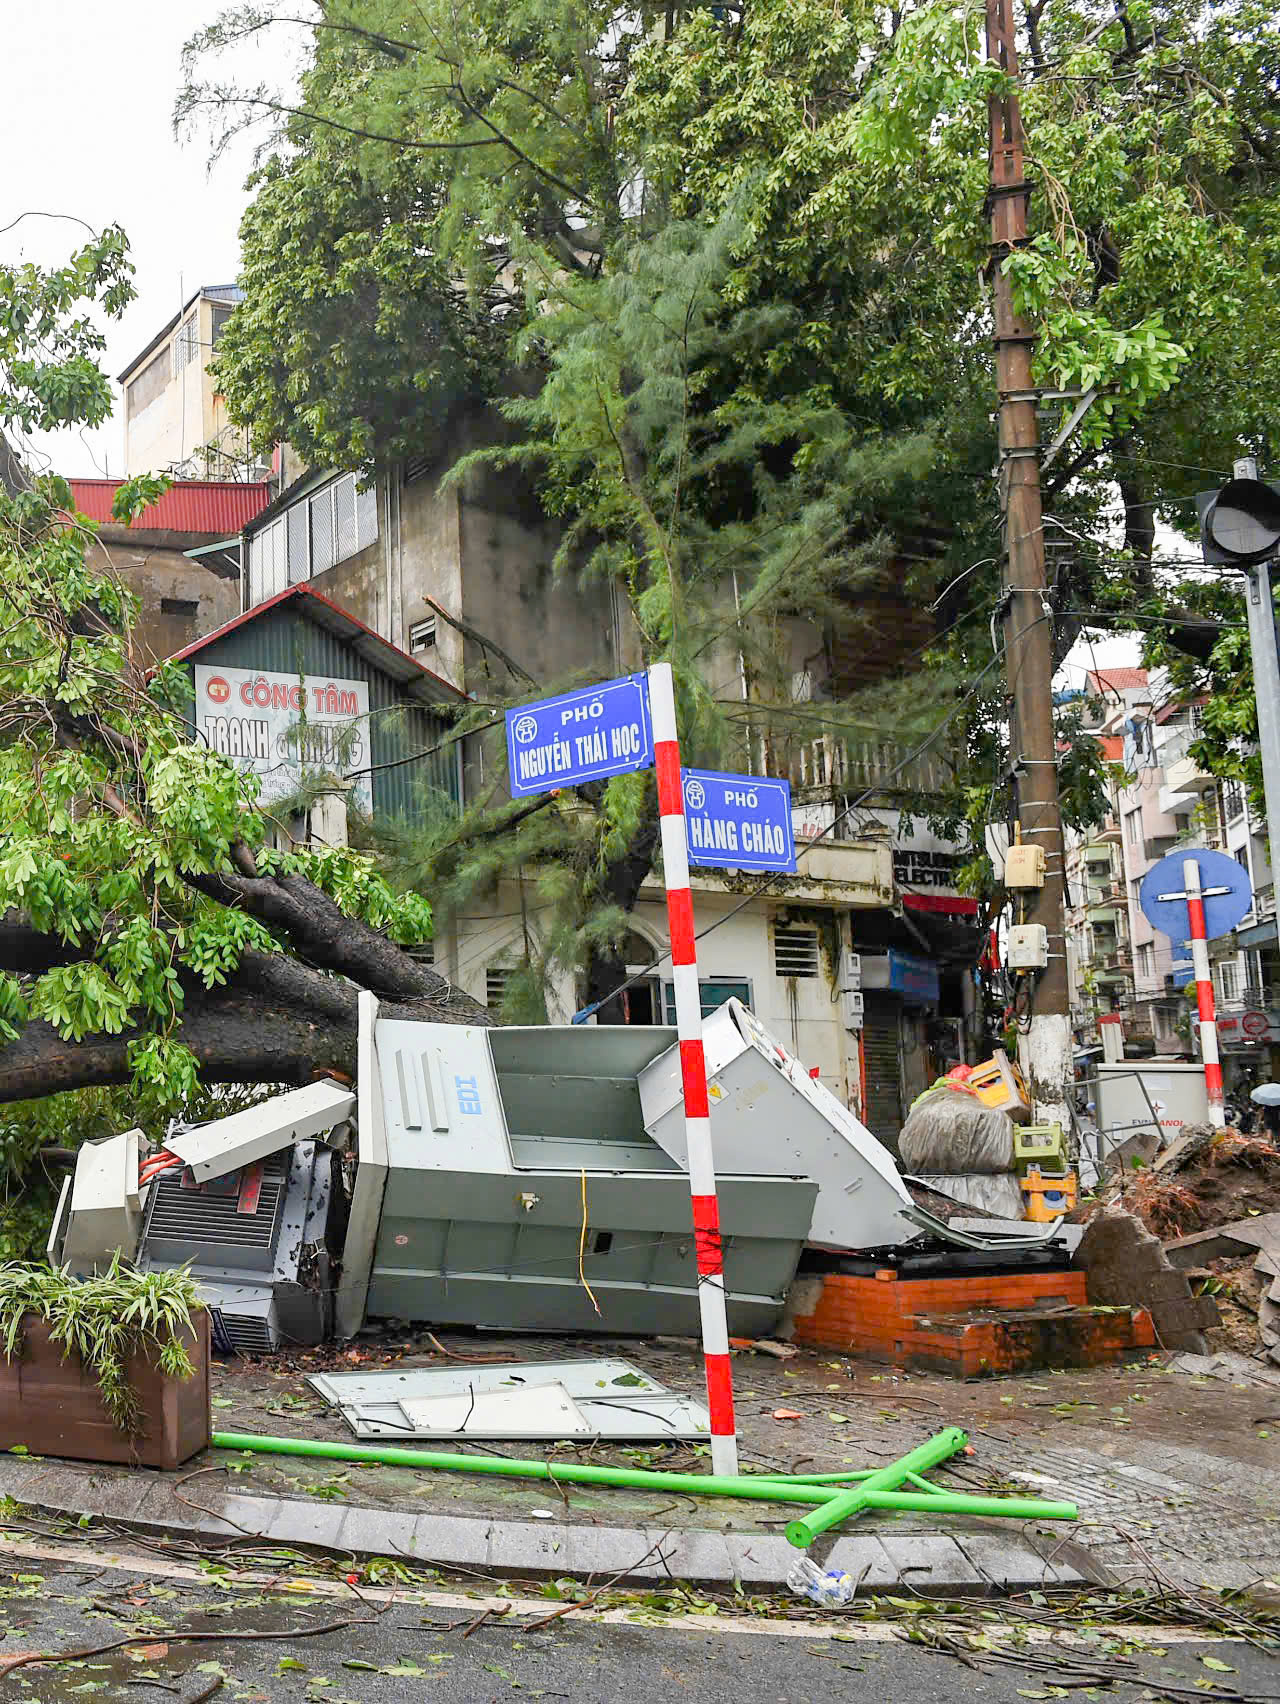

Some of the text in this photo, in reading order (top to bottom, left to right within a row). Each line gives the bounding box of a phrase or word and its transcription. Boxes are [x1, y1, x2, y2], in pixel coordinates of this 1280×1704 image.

[239, 676, 359, 716] CÔNG TÂM
[561, 693, 604, 726] PHỐ
[205, 716, 269, 759] TRANH
[520, 723, 640, 780] NGUYỄN THÁI HỌC
[725, 786, 759, 809] PHỐ
[690, 811, 737, 852] HÀNG
[742, 818, 785, 856] CHÁO
[1132, 1119, 1184, 1127] EVNANOI
